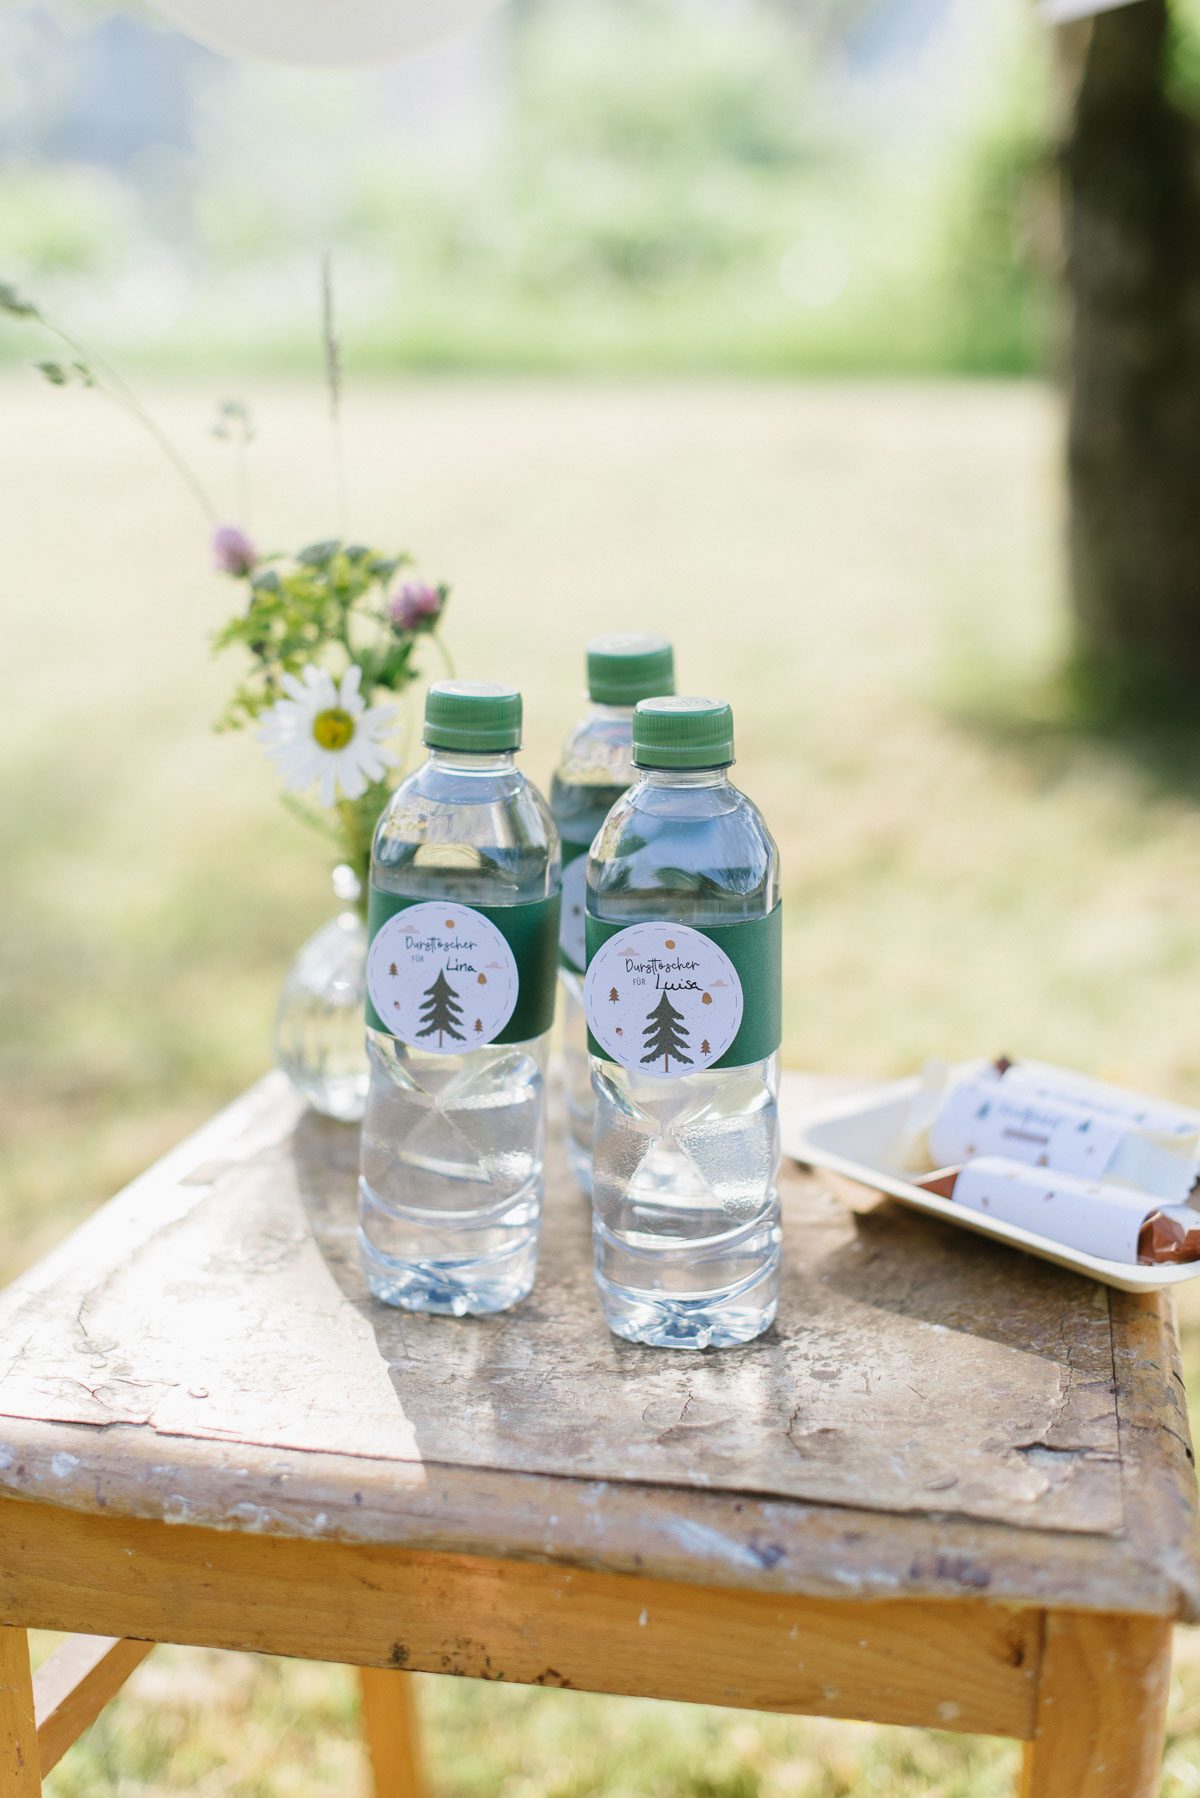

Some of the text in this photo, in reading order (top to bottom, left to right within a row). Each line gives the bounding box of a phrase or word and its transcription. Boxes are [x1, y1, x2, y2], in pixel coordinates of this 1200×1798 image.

[446, 955, 478, 973] Lina
[632, 976, 646, 986] FÜR
[655, 973, 704, 991] Luisa
